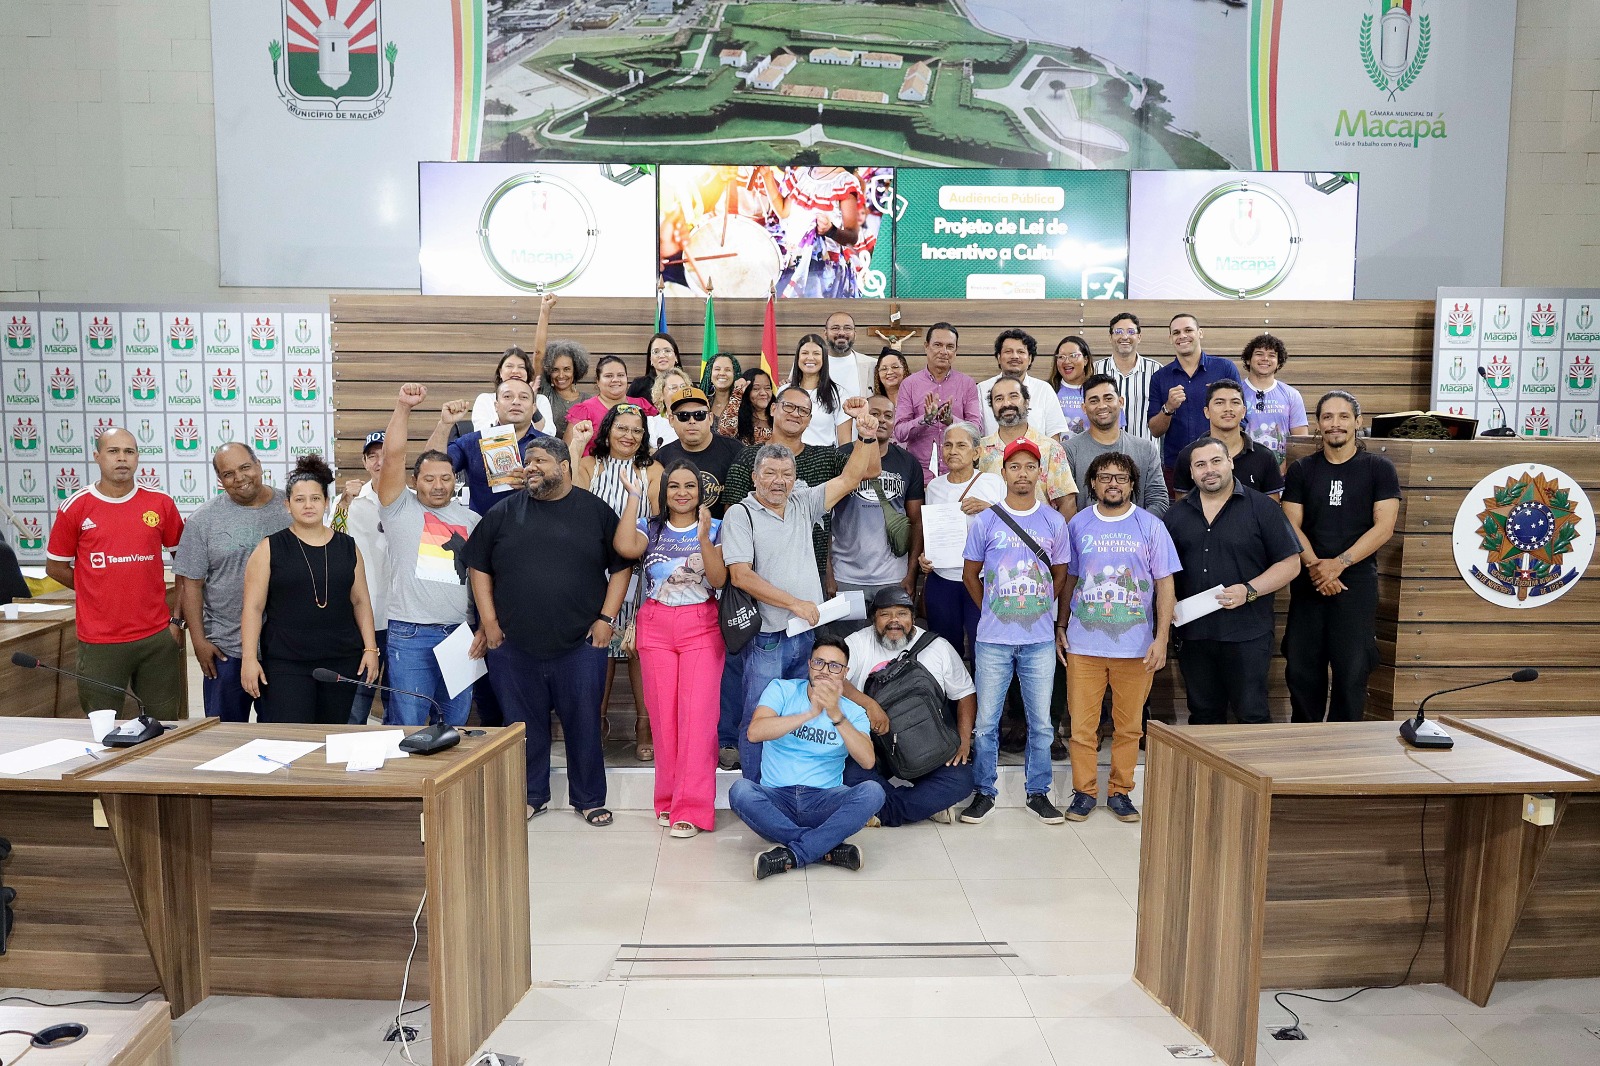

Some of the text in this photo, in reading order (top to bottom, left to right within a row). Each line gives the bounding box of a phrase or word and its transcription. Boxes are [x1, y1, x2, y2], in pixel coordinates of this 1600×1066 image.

[288, 105, 333, 118] MUNICÍPIO
[1334, 109, 1447, 148] Macapá
[949, 191, 1055, 205] Audiência Pública
[934, 216, 1068, 238] Projeto de Lei de
[921, 243, 1066, 260] Incentivo a Cultu
[994, 530, 1007, 549] 2
[1081, 534, 1093, 554] 2
[107, 553, 155, 564] TeamViewer
[1481, 575, 1487, 583] DE
[800, 724, 837, 741] PORIO
